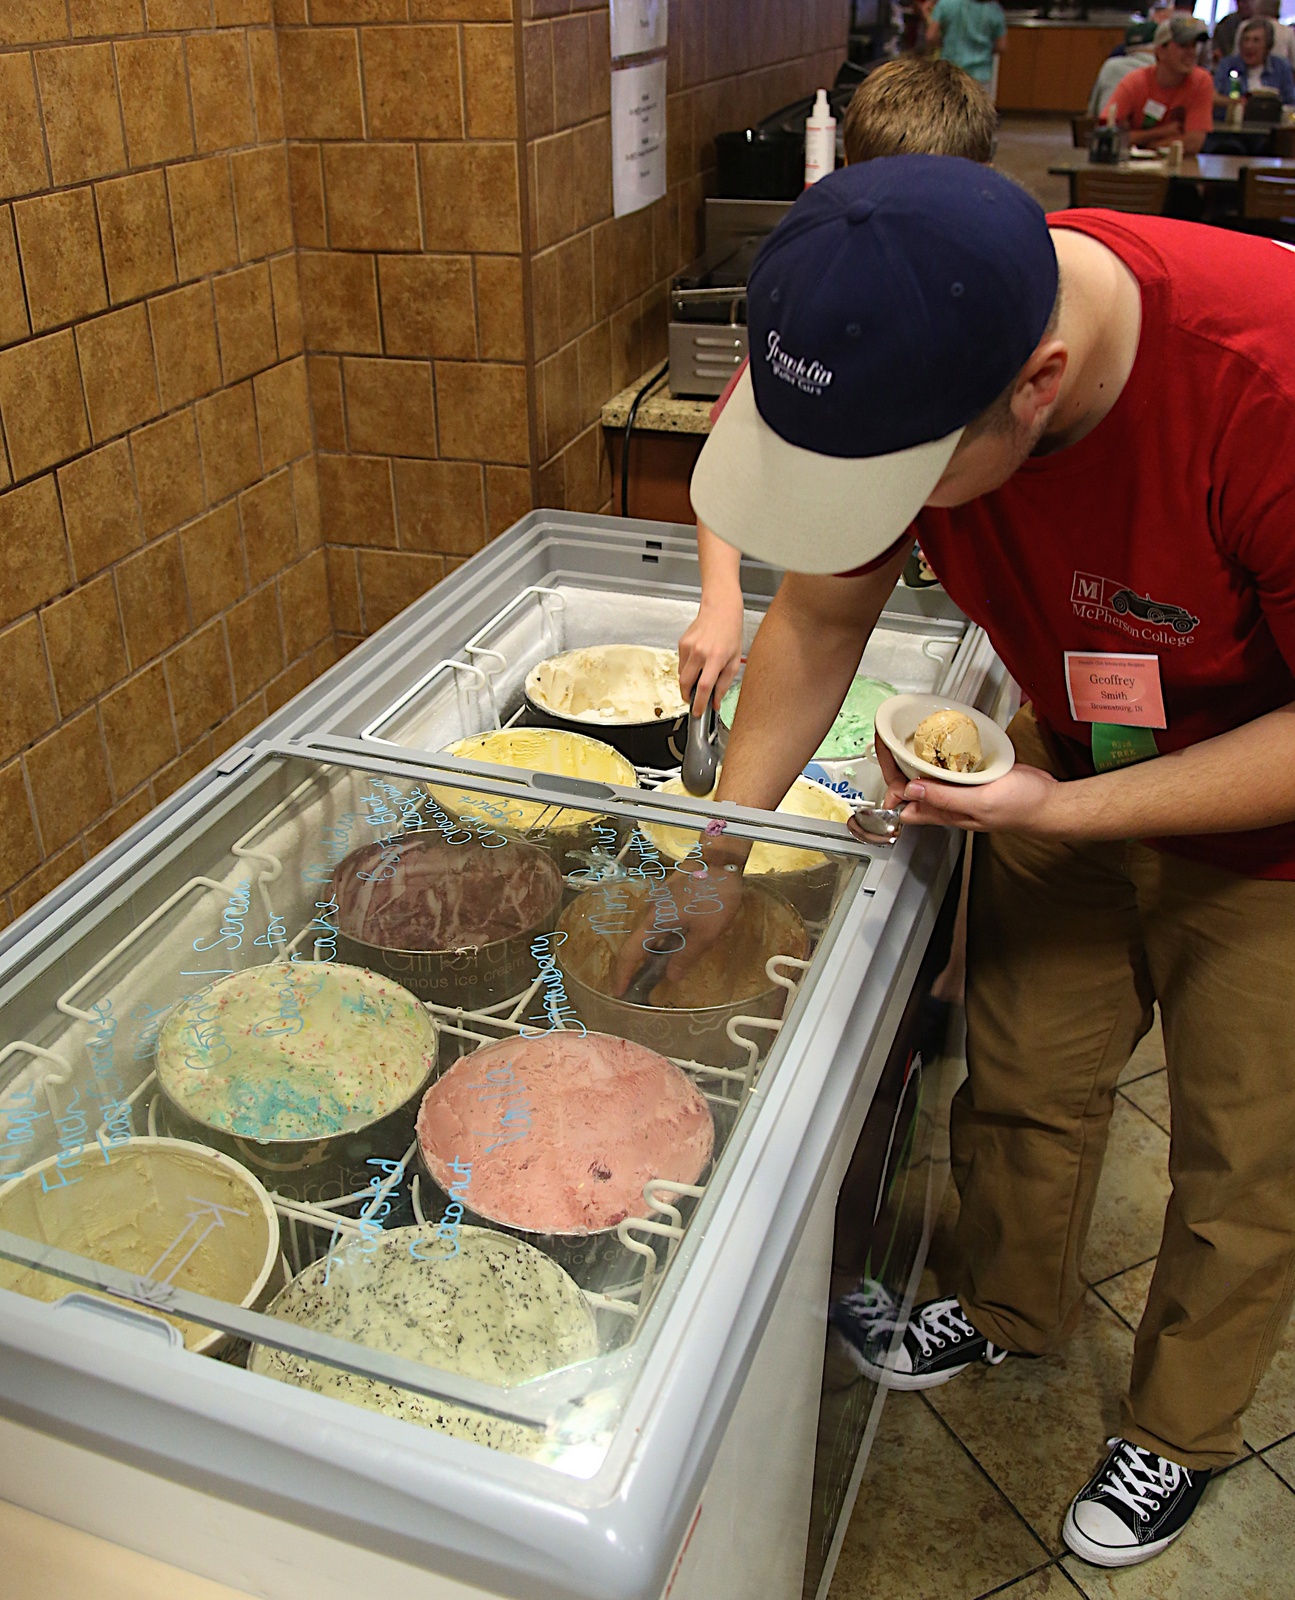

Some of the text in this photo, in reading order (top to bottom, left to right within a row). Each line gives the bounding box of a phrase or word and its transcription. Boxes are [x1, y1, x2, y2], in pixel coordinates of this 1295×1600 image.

[1072, 603, 1140, 639] McPherson
[1141, 627, 1195, 647] College
[1089, 674, 1136, 689] Geoffrey
[1100, 691, 1128, 701] Smith
[409, 786, 473, 846] Chocolate
[626, 827, 666, 881] Butter
[253, 911, 287, 949] for
[290, 893, 341, 965] Cake
[587, 884, 636, 936] Mint
[388, 955, 526, 989] famous ice cream
[519, 930, 588, 1040] Strawberry
[95, 1097, 133, 1165] Toast
[466, 1060, 532, 1154] Vanilla
[38, 1086, 89, 1194] French
[408, 1154, 474, 1261] Coconut
